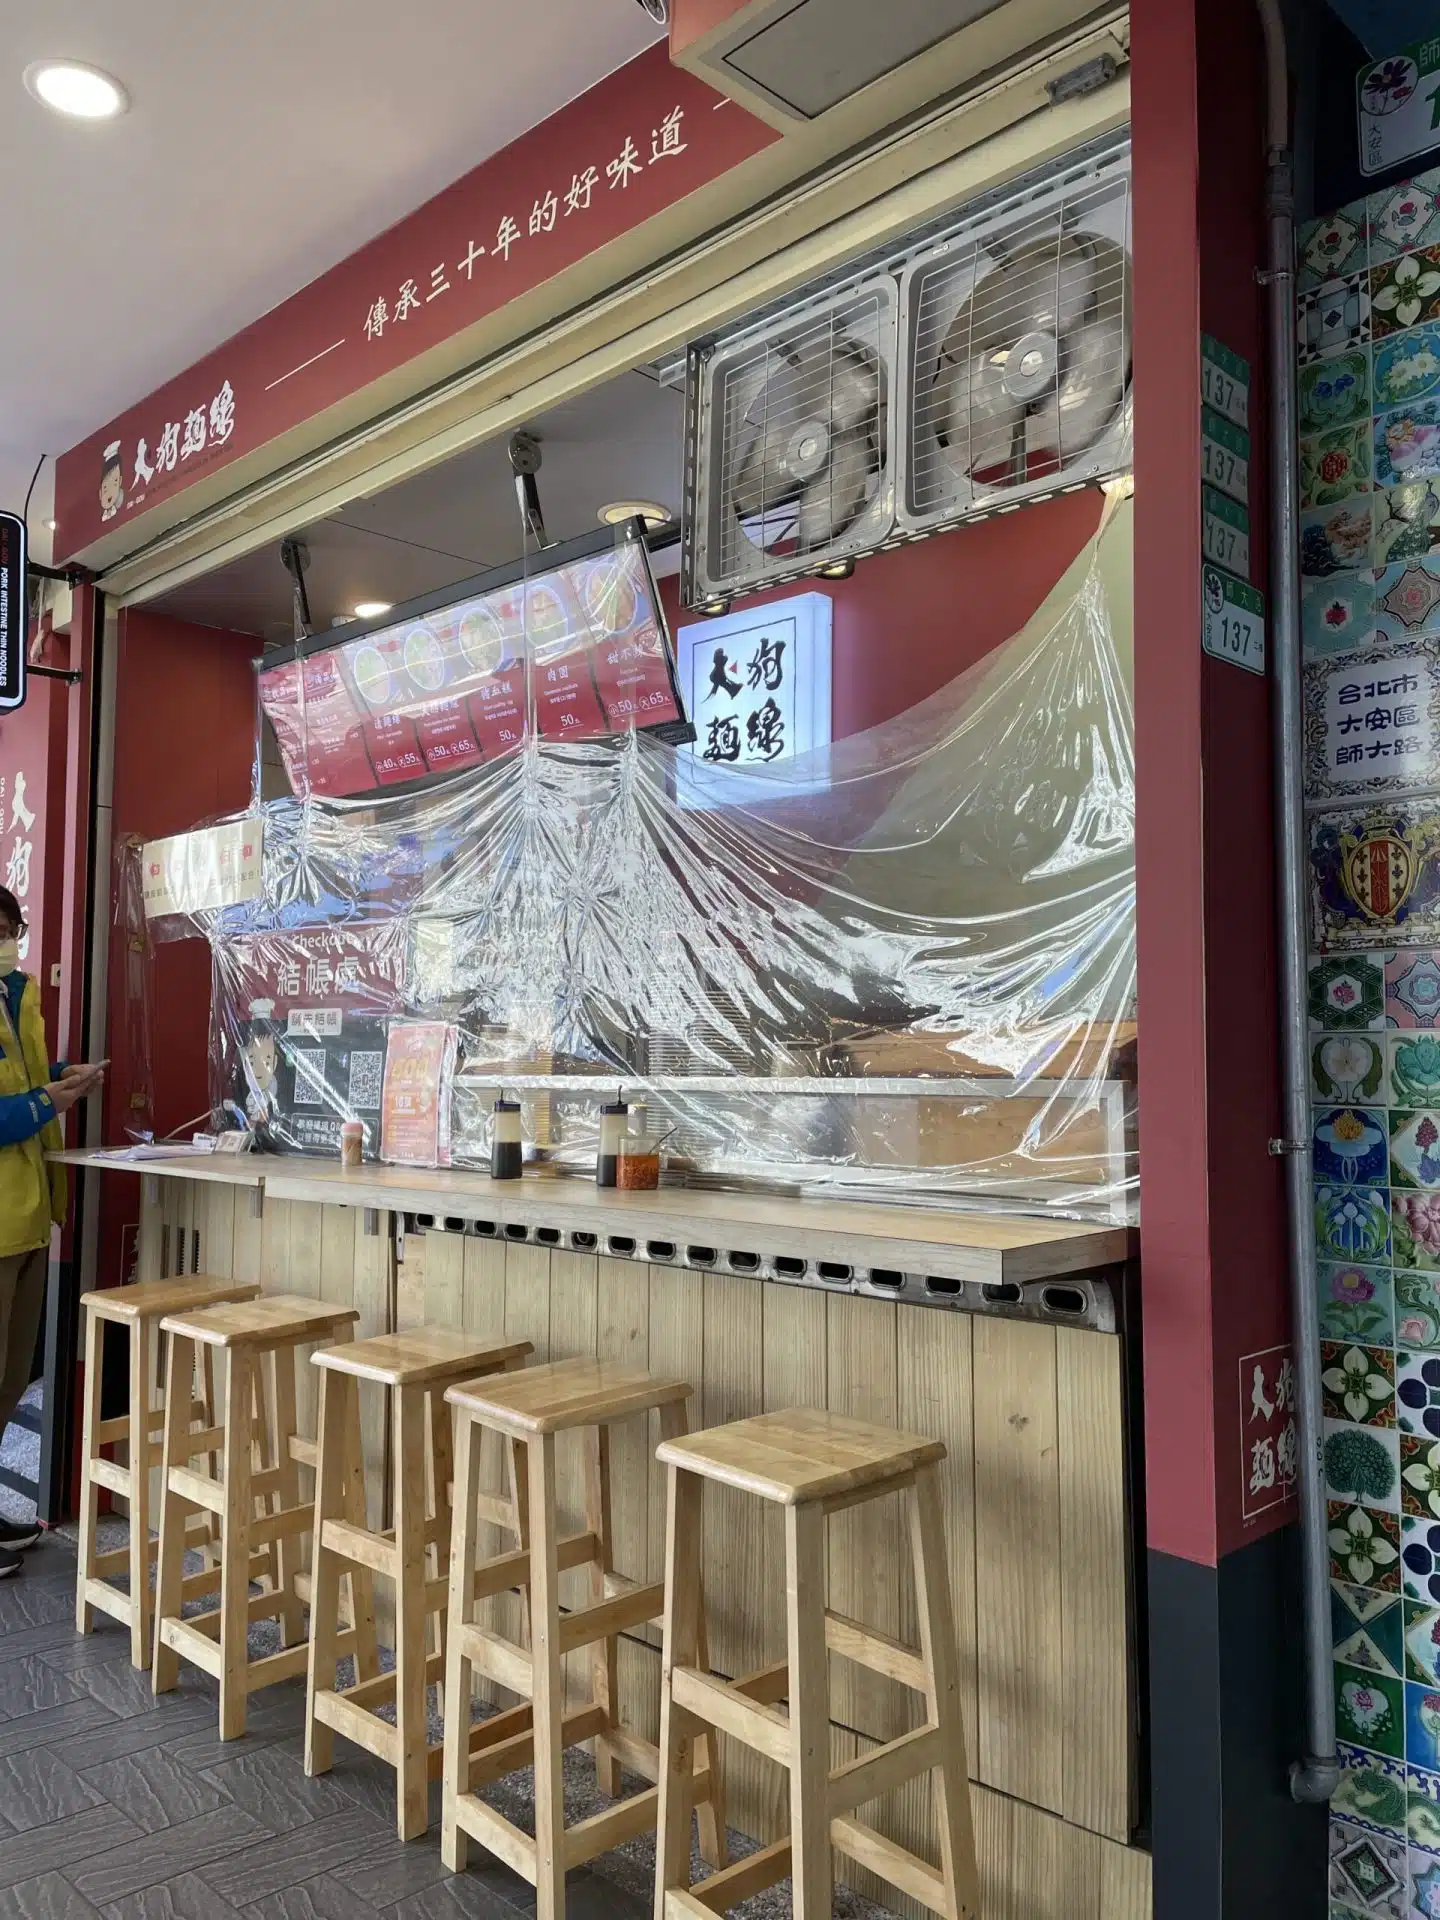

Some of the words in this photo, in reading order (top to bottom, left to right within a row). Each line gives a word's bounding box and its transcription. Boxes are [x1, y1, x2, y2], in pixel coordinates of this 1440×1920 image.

[363, 105, 689, 341] 傳承三十年的好味道
[1204, 368, 1234, 410] 137
[1204, 444, 1235, 486] 137
[1205, 515, 1237, 562] 137
[0, 590, 8, 628] INTESTINE
[0, 631, 8, 647] THIN
[1222, 616, 1251, 656] 137
[0, 649, 8, 686] NOODLES
[1338, 673, 1418, 705] 台北市
[1337, 704, 1421, 735] 大安區
[1336, 735, 1423, 766] 師大路
